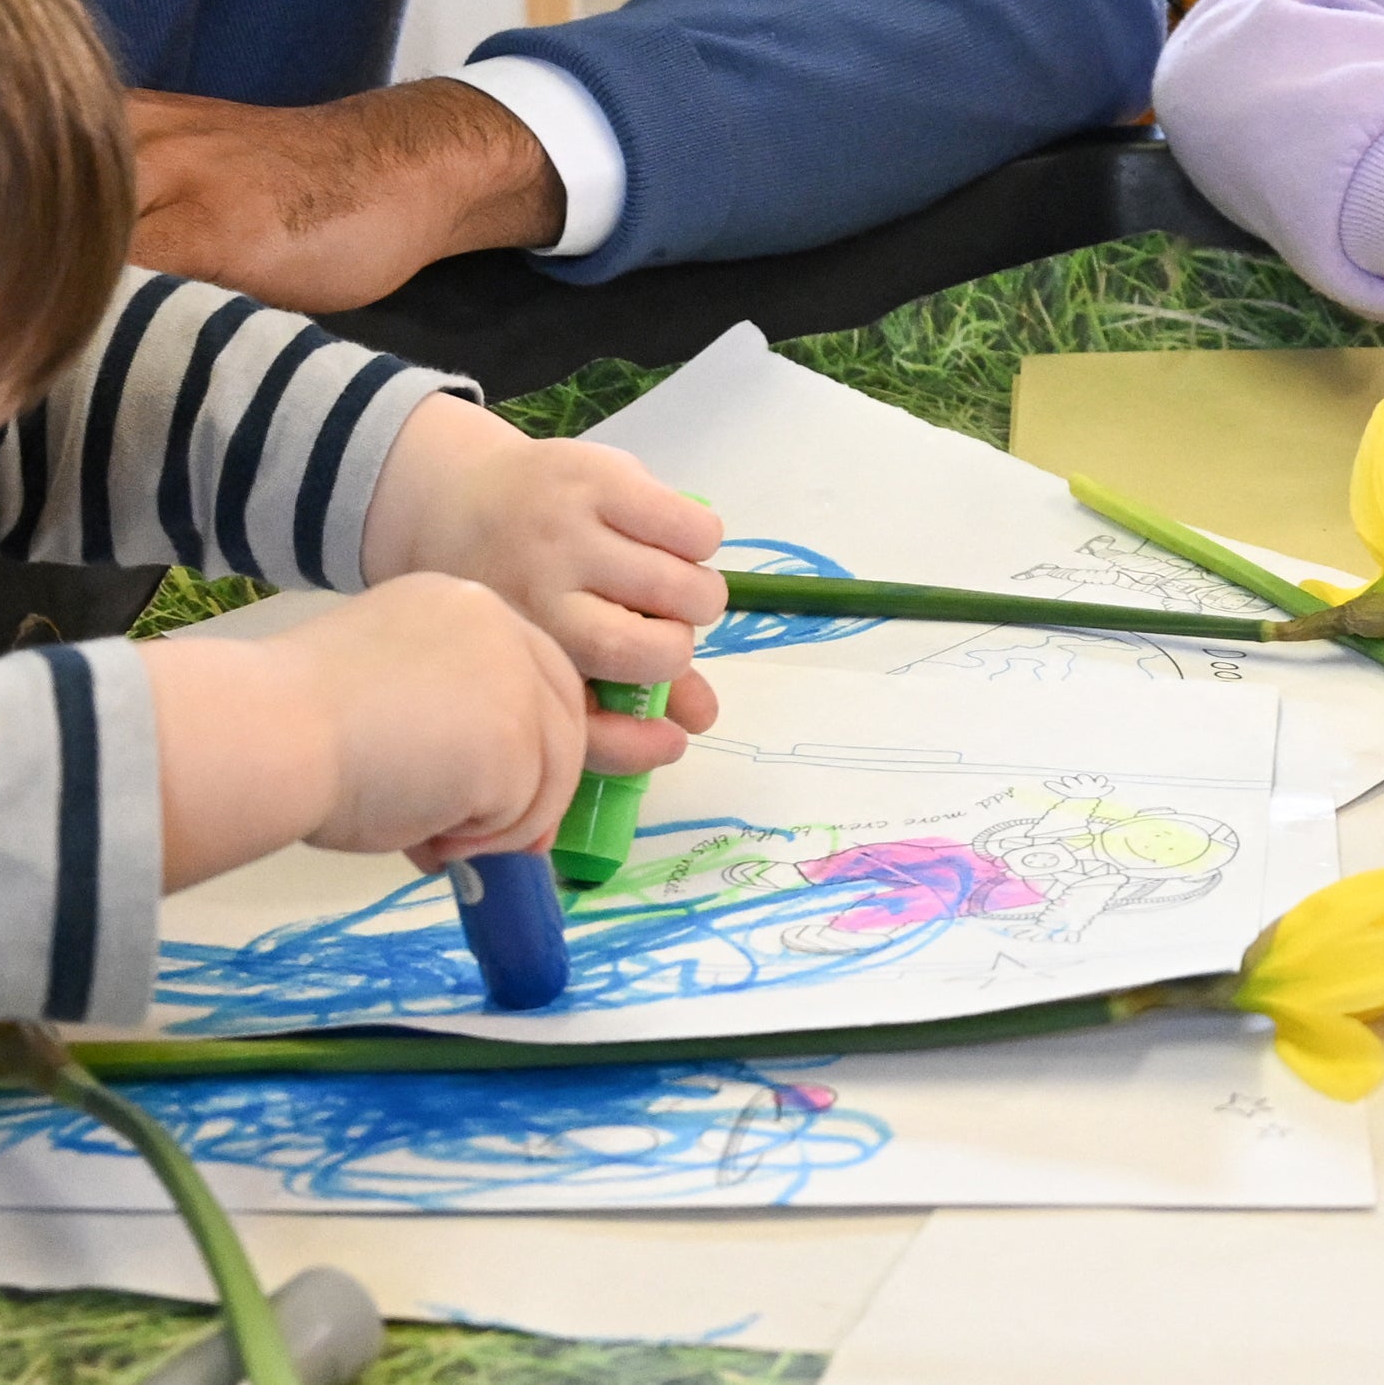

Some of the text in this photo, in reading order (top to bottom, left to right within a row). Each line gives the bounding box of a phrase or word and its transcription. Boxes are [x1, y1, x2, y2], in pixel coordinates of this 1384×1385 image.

[975, 786, 1015, 810] Add
[825, 820, 888, 831] crew
[904, 810, 968, 826] more
[740, 824, 777, 843] fly
[790, 825, 812, 838] to
[691, 833, 730, 856] this
